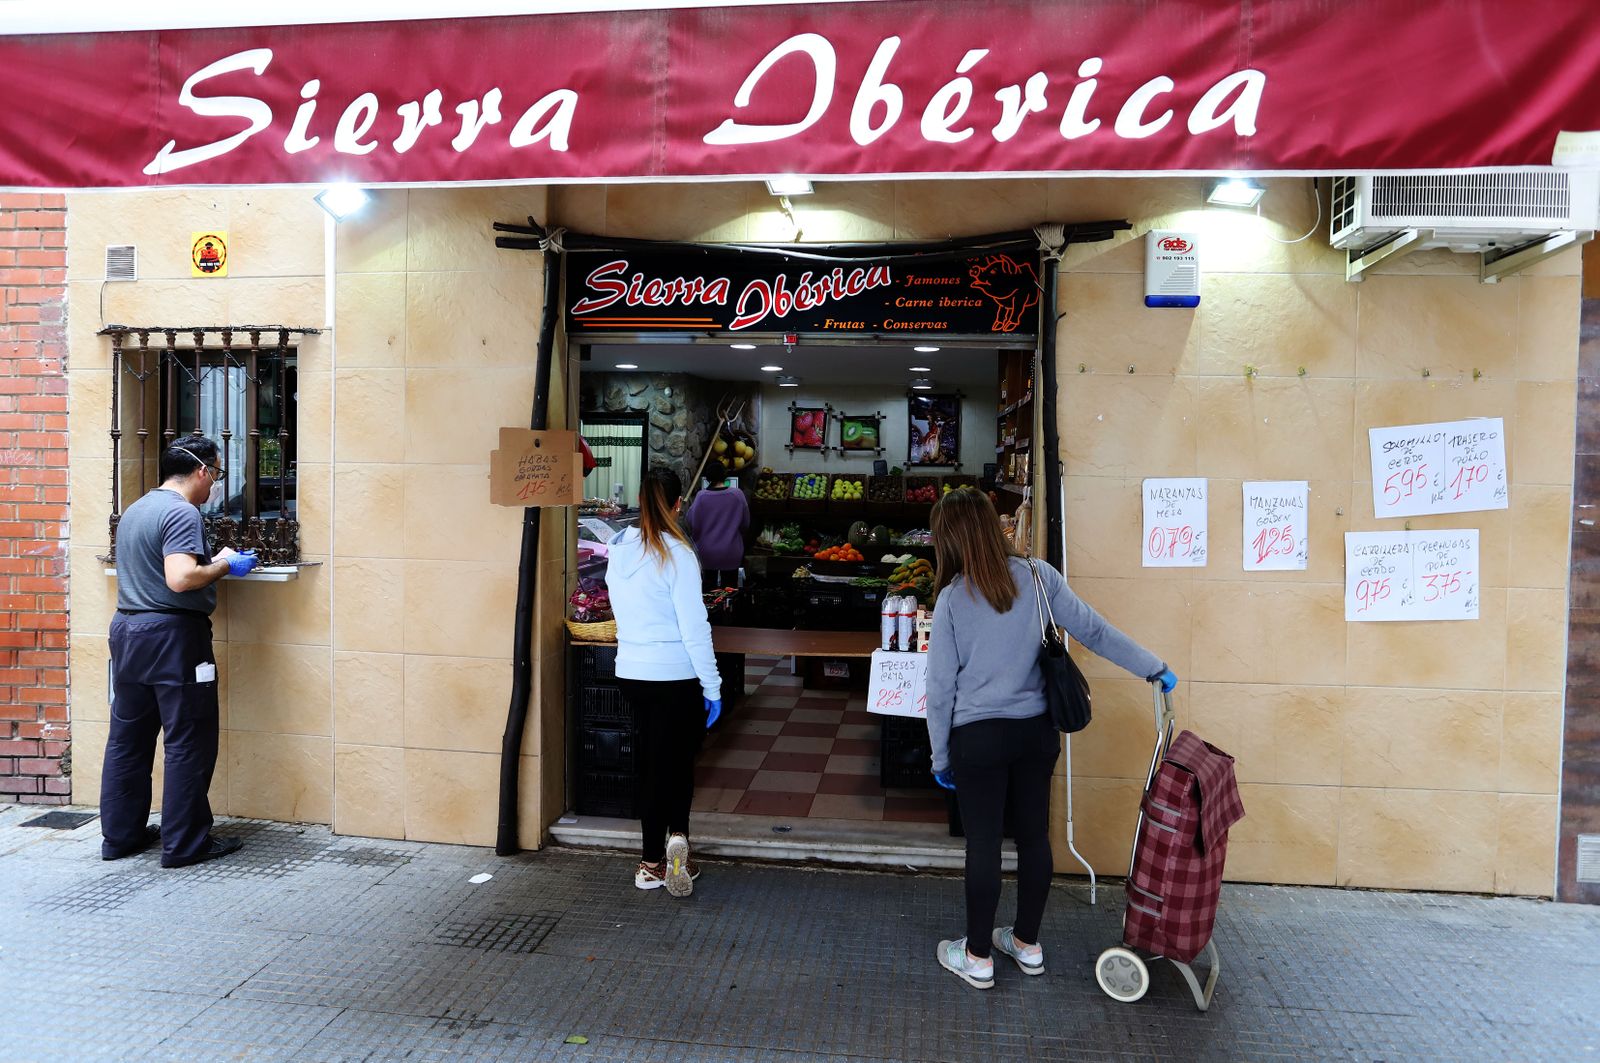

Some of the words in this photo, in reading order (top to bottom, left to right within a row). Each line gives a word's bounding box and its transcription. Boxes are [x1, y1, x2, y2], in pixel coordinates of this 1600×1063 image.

[143, 48, 579, 176] Sierra
[703, 33, 1267, 147] Ibérica
[904, 275, 961, 288] Jamones
[571, 260, 730, 314] Sierra
[729, 265, 892, 331] Ibérica
[895, 297, 934, 308] Carne
[939, 296, 984, 308] iberica
[823, 318, 866, 330] Frutas
[883, 318, 948, 330] Conservas
[1249, 496, 1304, 509] MANZANAS
